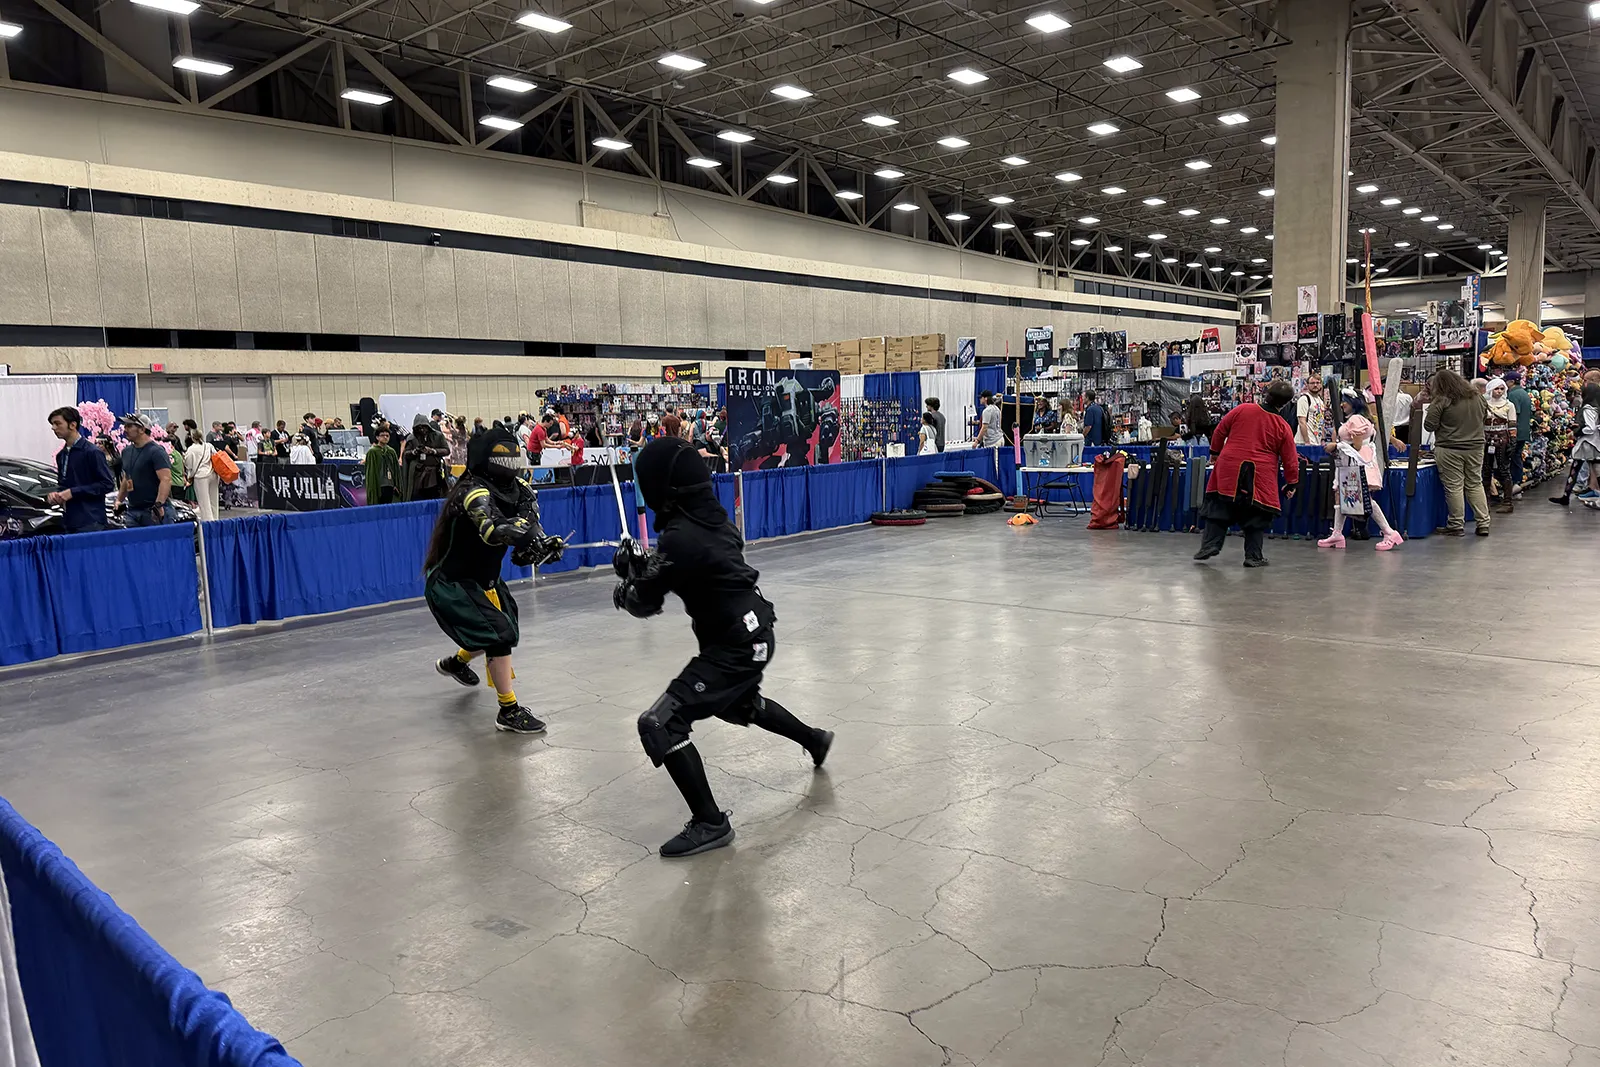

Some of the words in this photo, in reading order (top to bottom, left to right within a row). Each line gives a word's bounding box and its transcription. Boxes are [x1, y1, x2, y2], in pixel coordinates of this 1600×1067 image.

[677, 367, 699, 376] records
[728, 368, 776, 399] IRON
[272, 476, 291, 498] VR
[293, 477, 336, 499] VILLA
